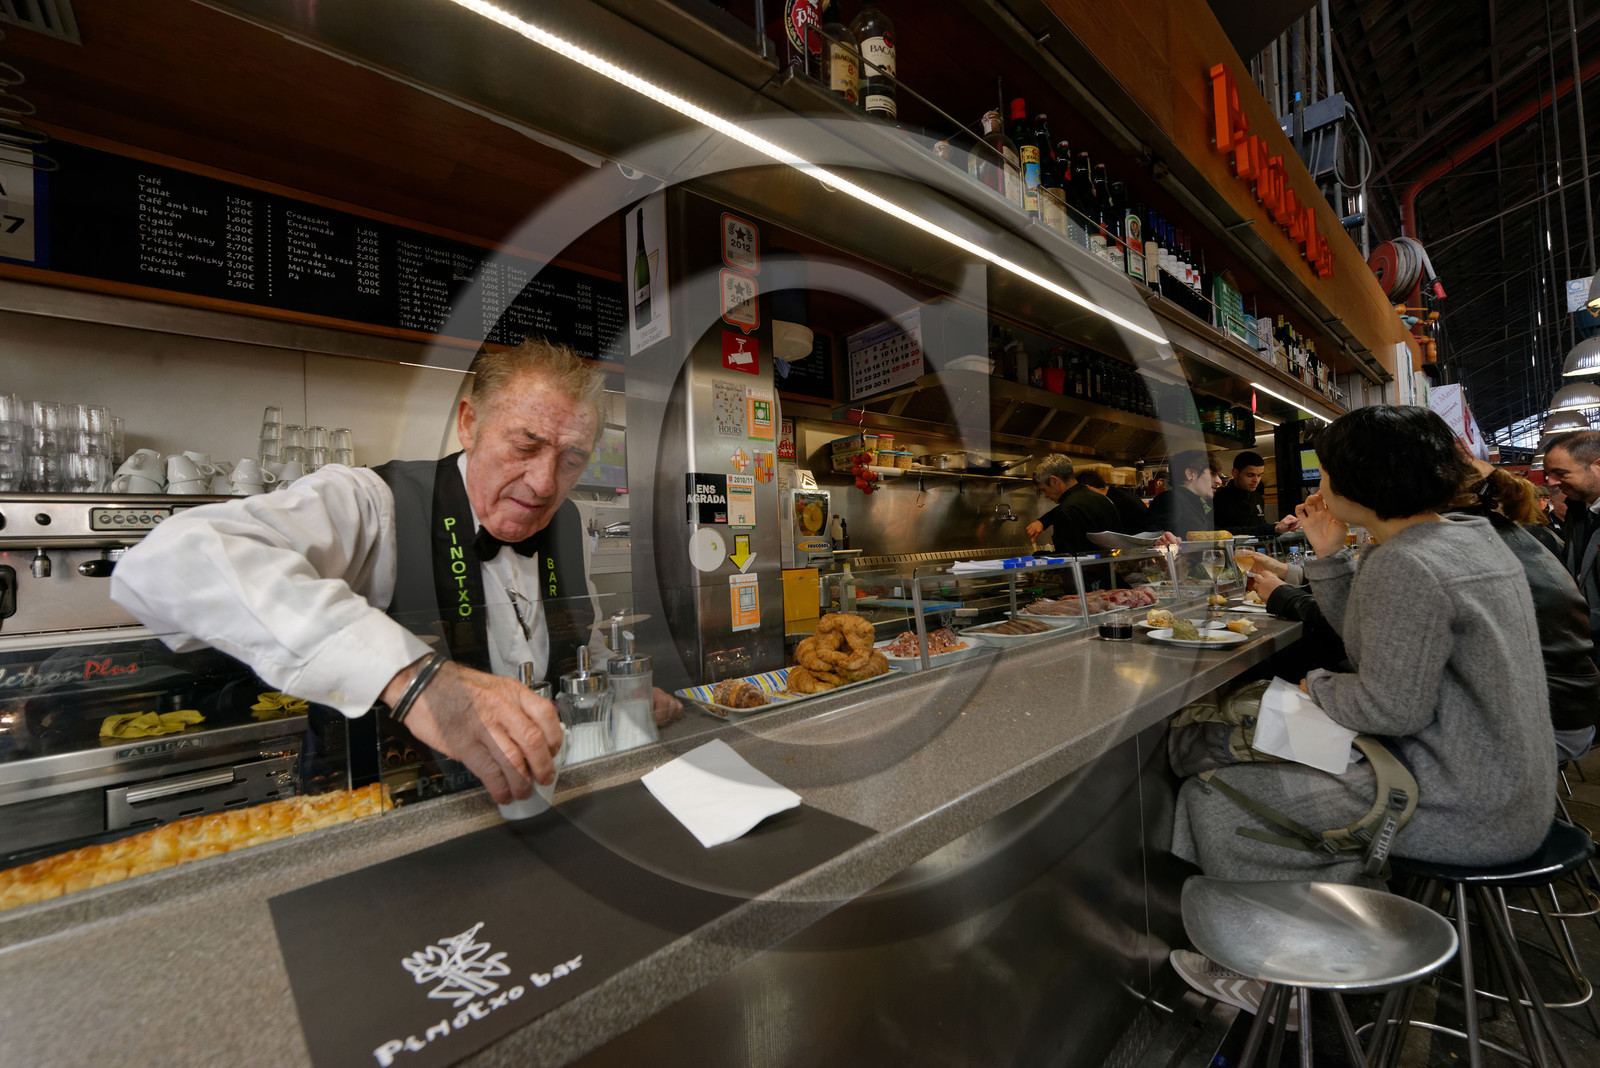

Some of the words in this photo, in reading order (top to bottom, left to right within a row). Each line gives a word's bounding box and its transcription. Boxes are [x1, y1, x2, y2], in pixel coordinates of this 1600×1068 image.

[138, 174, 162, 186] Café
[139, 184, 171, 198] Tallat
[138, 194, 162, 205] Café
[166, 202, 188, 211] amb
[191, 206, 209, 216] llet
[139, 204, 182, 220] Biberón
[139, 214, 174, 227] Cigaló
[287, 219, 335, 236] Ensaimada
[139, 224, 174, 236] Cigaló
[177, 232, 216, 247] Whisky
[287, 228, 310, 239] Xuxo
[287, 237, 317, 249] Tortell
[730, 238, 751, 253] 2012
[187, 254, 224, 267] whisky
[287, 246, 309, 256] Flam
[335, 257, 354, 266] casa
[288, 254, 327, 269] Torrades
[140, 263, 186, 278] Cacaolat
[288, 264, 304, 273] Mel
[313, 269, 336, 278] Mató
[730, 294, 750, 307] 2011
[881, 350, 889, 358] 10
[718, 424, 743, 435] HOURS
[734, 476, 753, 484] 2010/11
[696, 484, 716, 494] ENS
[686, 493, 726, 505] AGRADA
[443, 517, 473, 617] PINOTXO
[546, 557, 558, 597] BAR
[84, 658, 139, 680] Plus
[1373, 816, 1398, 862] MILLET
[530, 953, 583, 988] bar
